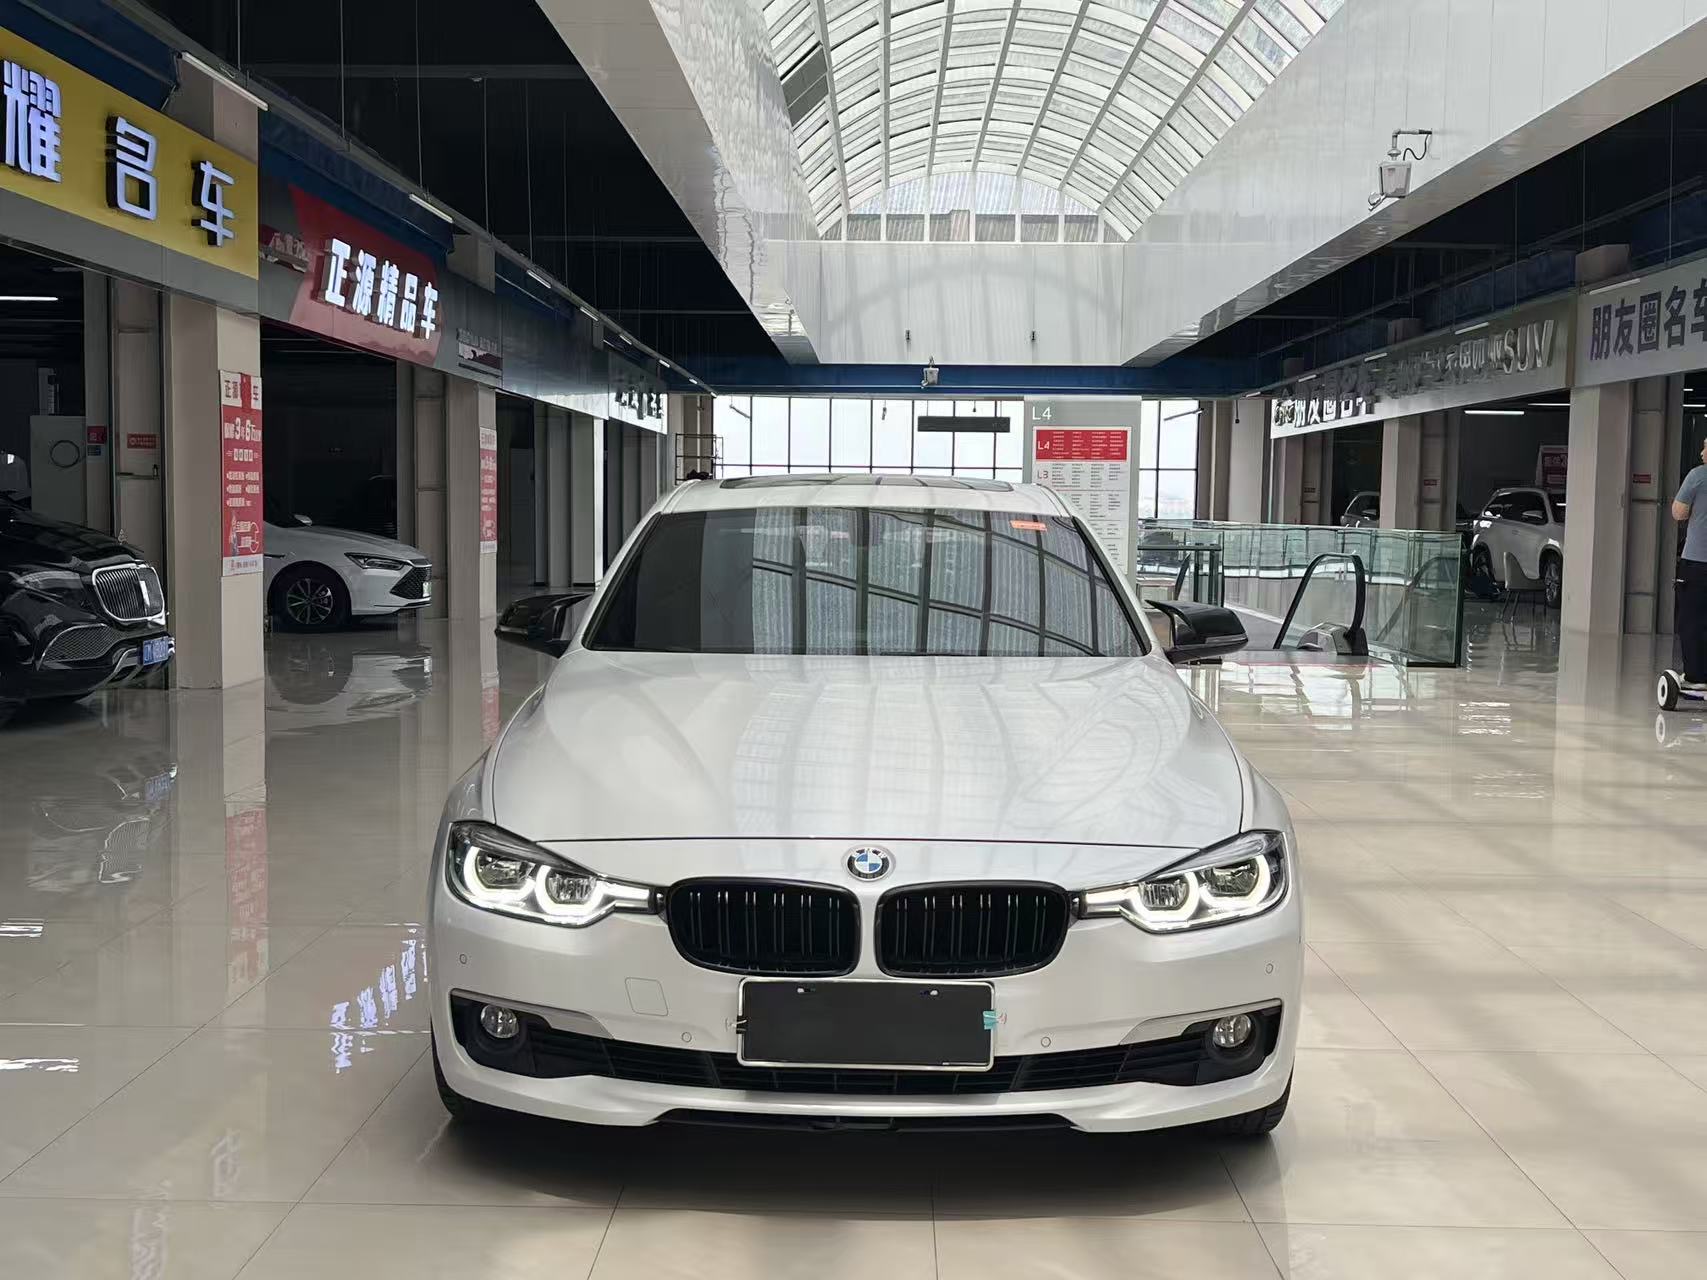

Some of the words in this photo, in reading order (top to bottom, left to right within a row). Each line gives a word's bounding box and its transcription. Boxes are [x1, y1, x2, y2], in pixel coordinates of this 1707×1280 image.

[3, 60, 235, 248] 耀名车
[325, 238, 439, 340] 正源精品车
[1590, 278, 1707, 361] 朋友圈名车
[1503, 320, 1555, 374] SUV
[1032, 406, 1052, 420] L4
[1037, 440, 1050, 450] L4
[1036, 470, 1049, 479] L3
